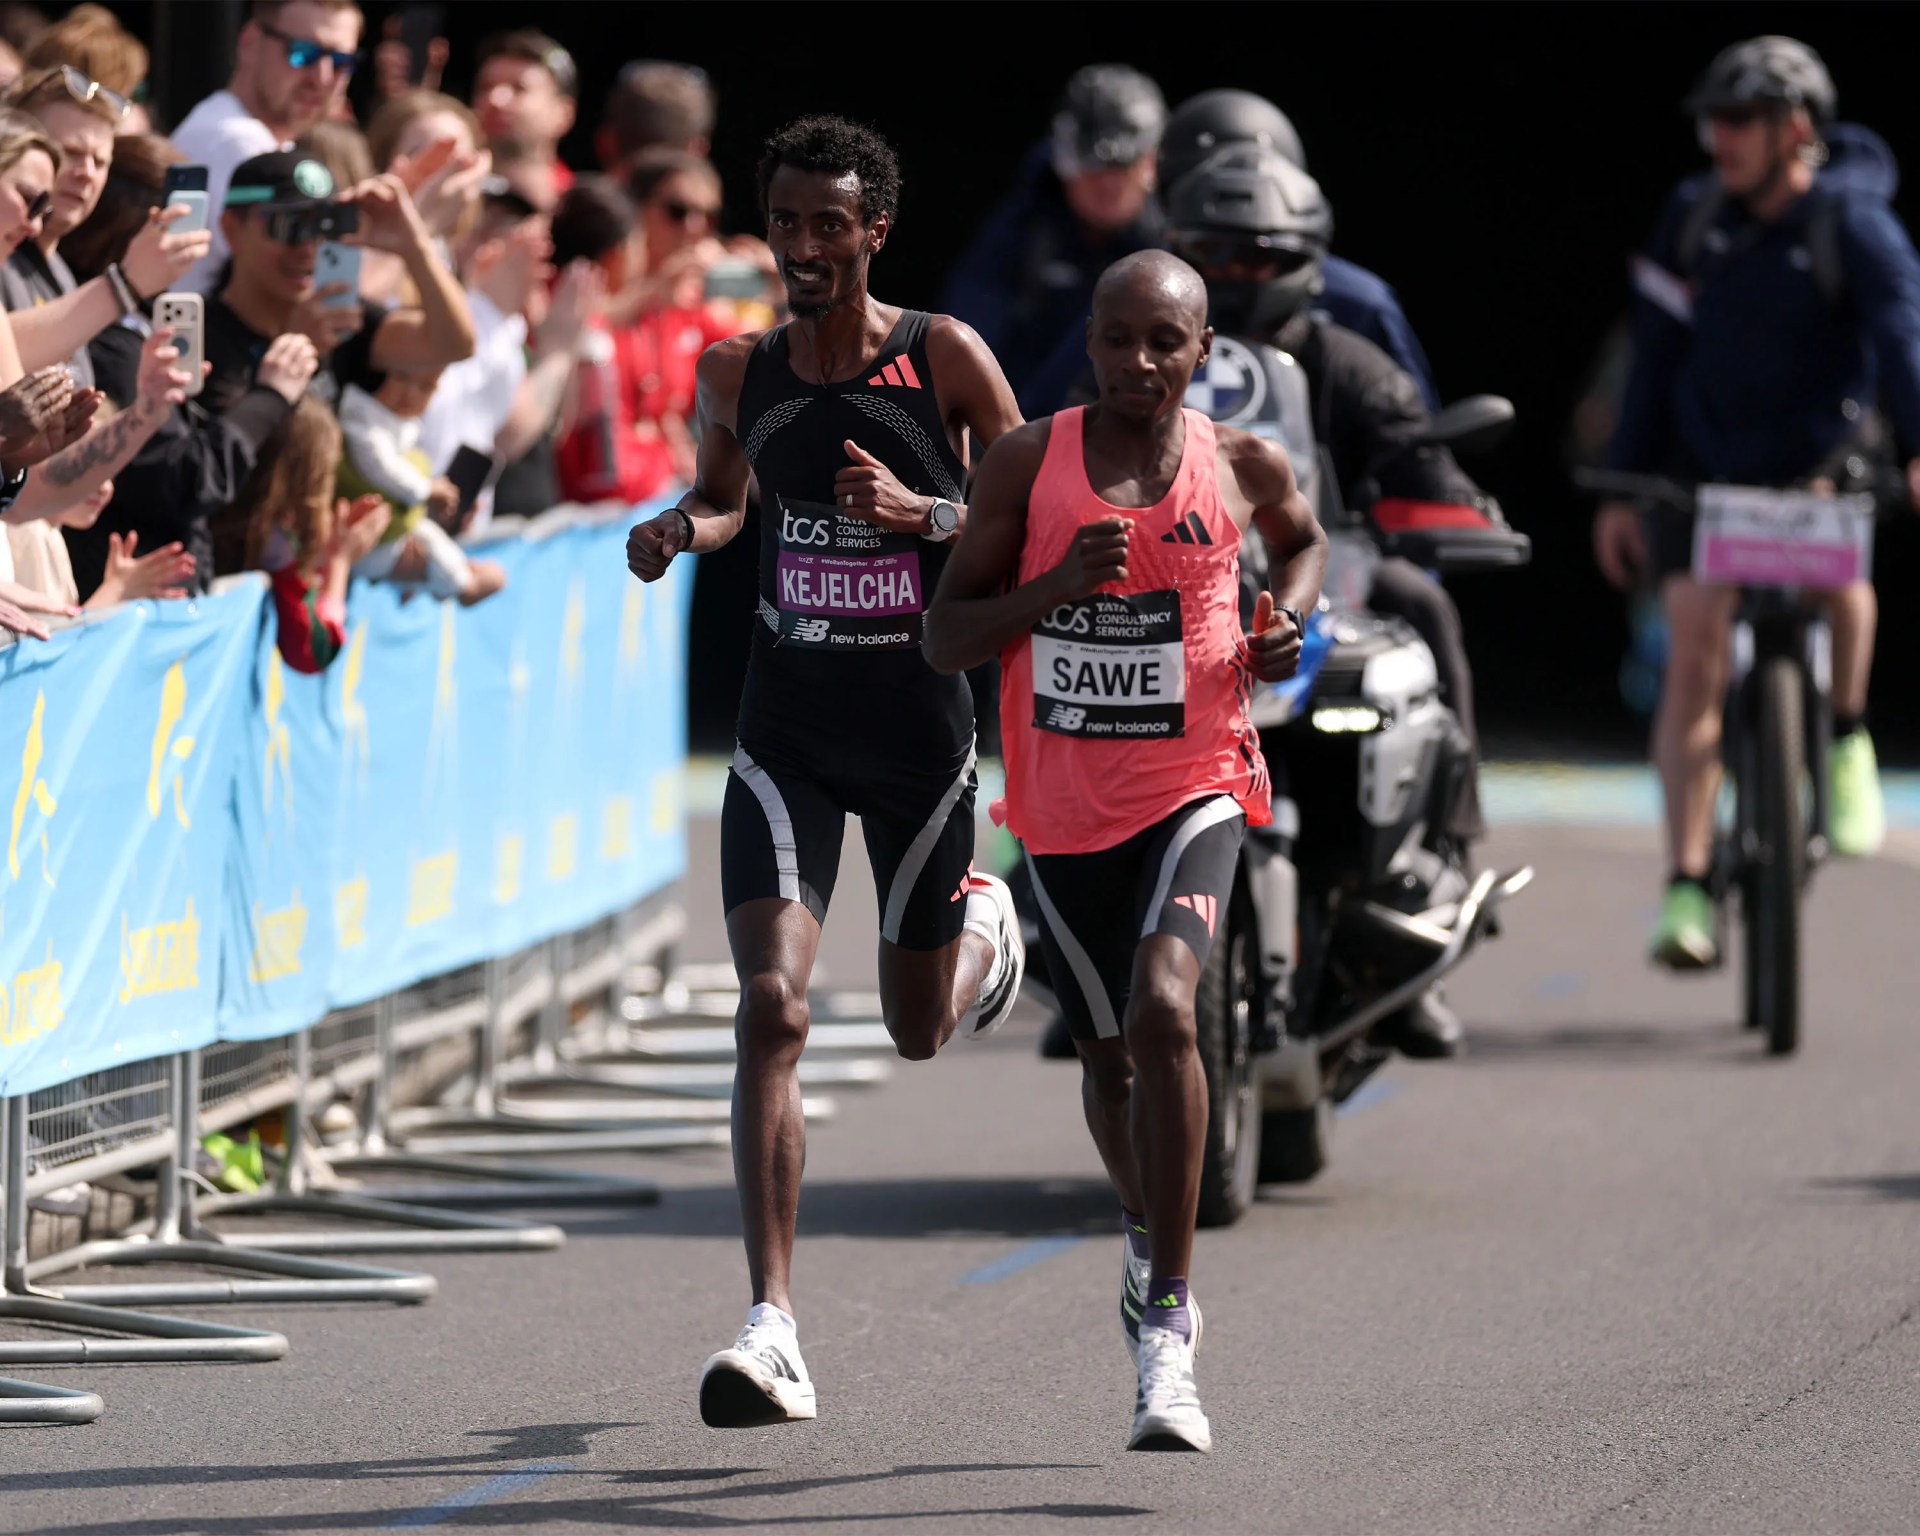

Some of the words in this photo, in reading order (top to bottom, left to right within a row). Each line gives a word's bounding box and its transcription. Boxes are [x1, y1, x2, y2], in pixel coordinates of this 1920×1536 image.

[782, 508, 830, 546] tcs
[835, 537, 881, 549] SERVICES
[782, 567, 916, 610] KEJELCHA
[1095, 602, 1129, 613] TATA
[1095, 611, 1172, 625] CONSULTANCY
[830, 633, 855, 644] new
[858, 632, 910, 645] balance
[1095, 626, 1146, 638] SERVICES
[1052, 656, 1161, 697] SAWE
[1086, 721, 1113, 733] new
[1115, 720, 1170, 734] balance
